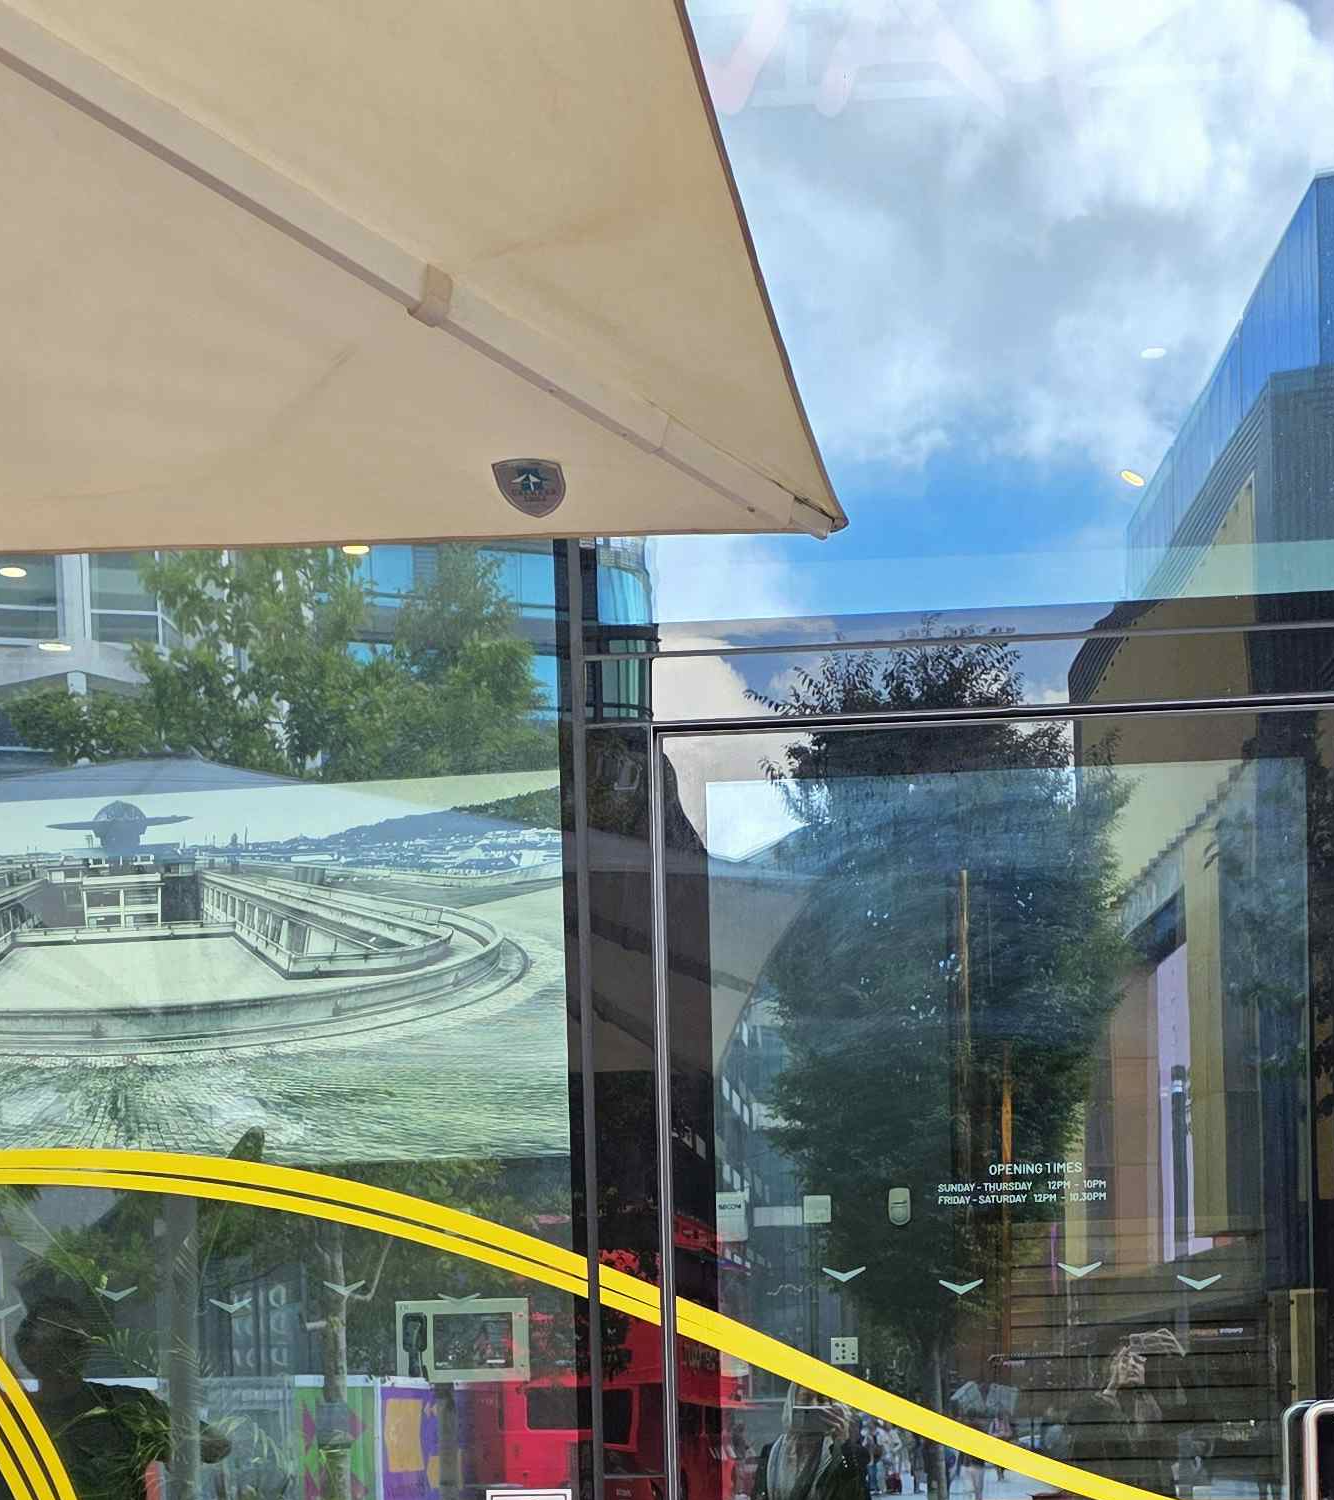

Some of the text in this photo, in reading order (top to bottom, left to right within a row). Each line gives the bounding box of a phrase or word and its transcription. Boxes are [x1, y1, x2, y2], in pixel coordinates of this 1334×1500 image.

[988, 1162, 1083, 1175] OPENING TIMES
[937, 1183, 976, 1193] SUNDAY
[984, 1181, 1033, 1192] THURSDAY
[1047, 1180, 1070, 1190] 12PM
[1083, 1179, 1107, 1189] 10PM
[938, 1195, 971, 1205] FRIDAY
[978, 1194, 1027, 1204] SATURDAY
[1033, 1193, 1056, 1203] 12PM
